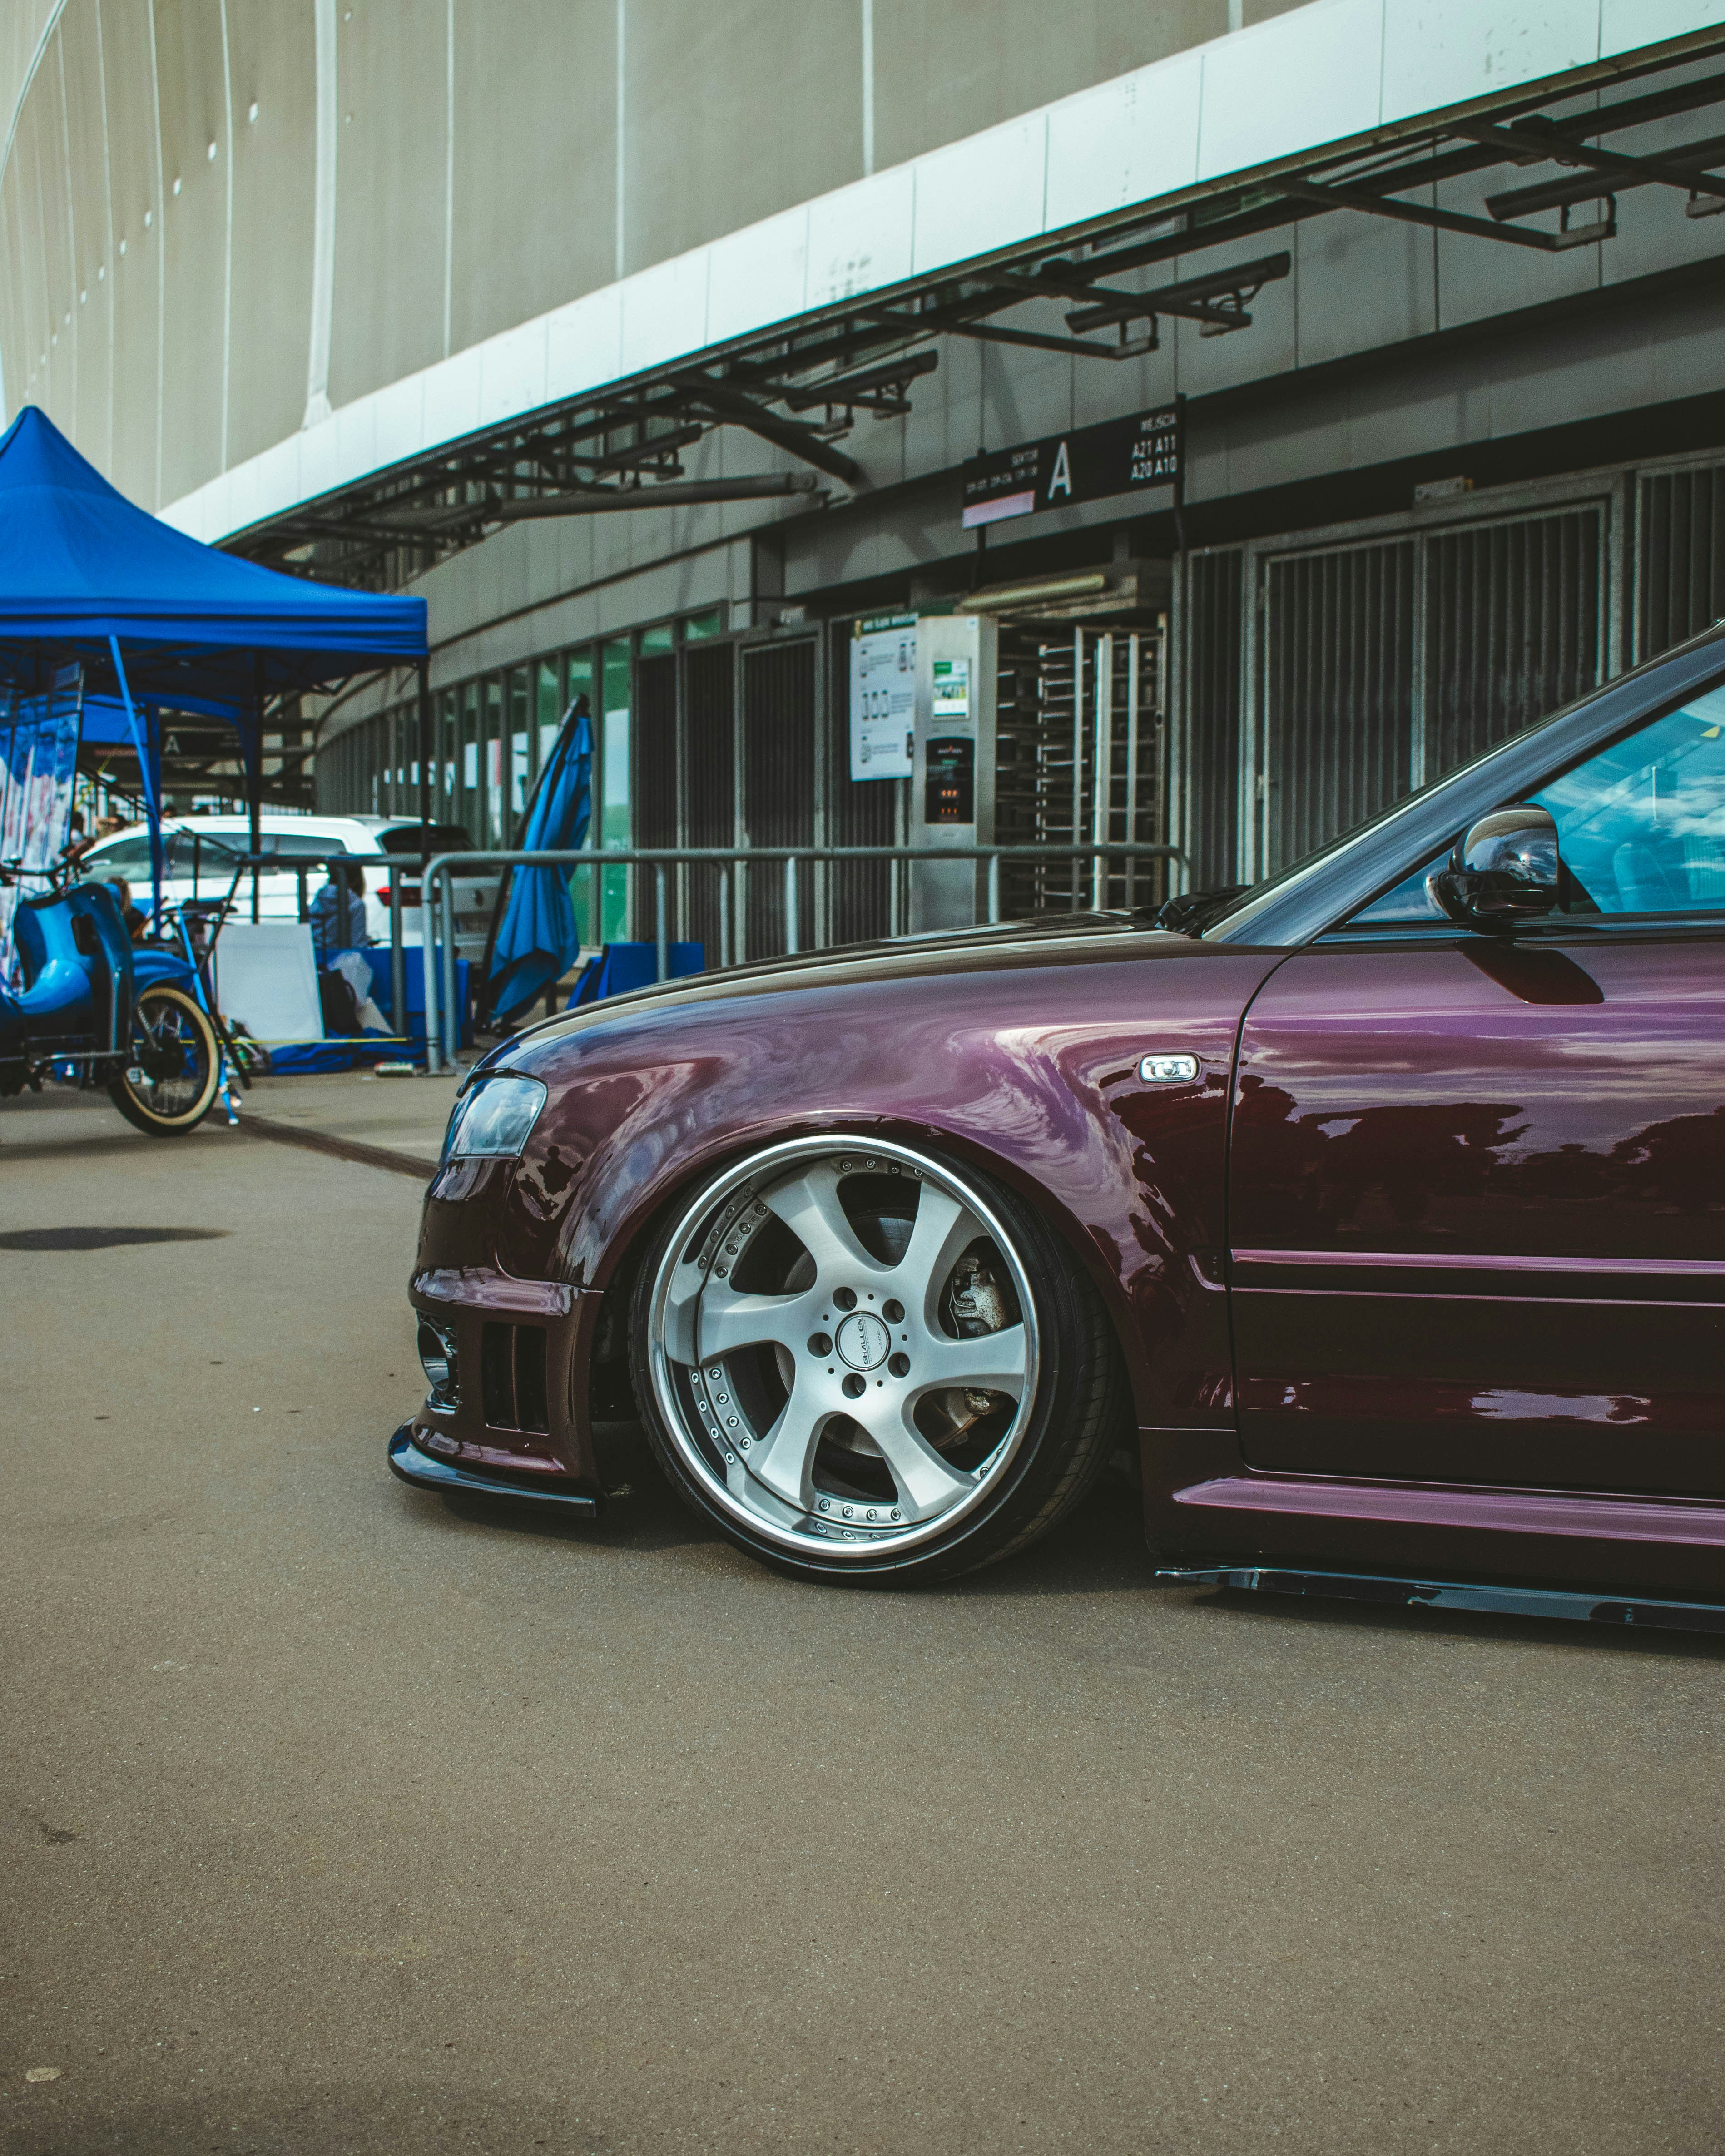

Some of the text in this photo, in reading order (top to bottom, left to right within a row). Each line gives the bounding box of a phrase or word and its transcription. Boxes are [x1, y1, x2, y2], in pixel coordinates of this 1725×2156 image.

[1132, 435, 1175, 459] A21 A11
[1048, 441, 1071, 500] A
[1131, 455, 1177, 481] A20 A10
[164, 735, 180, 754] A
[858, 1318, 869, 1364] SHALLEN
